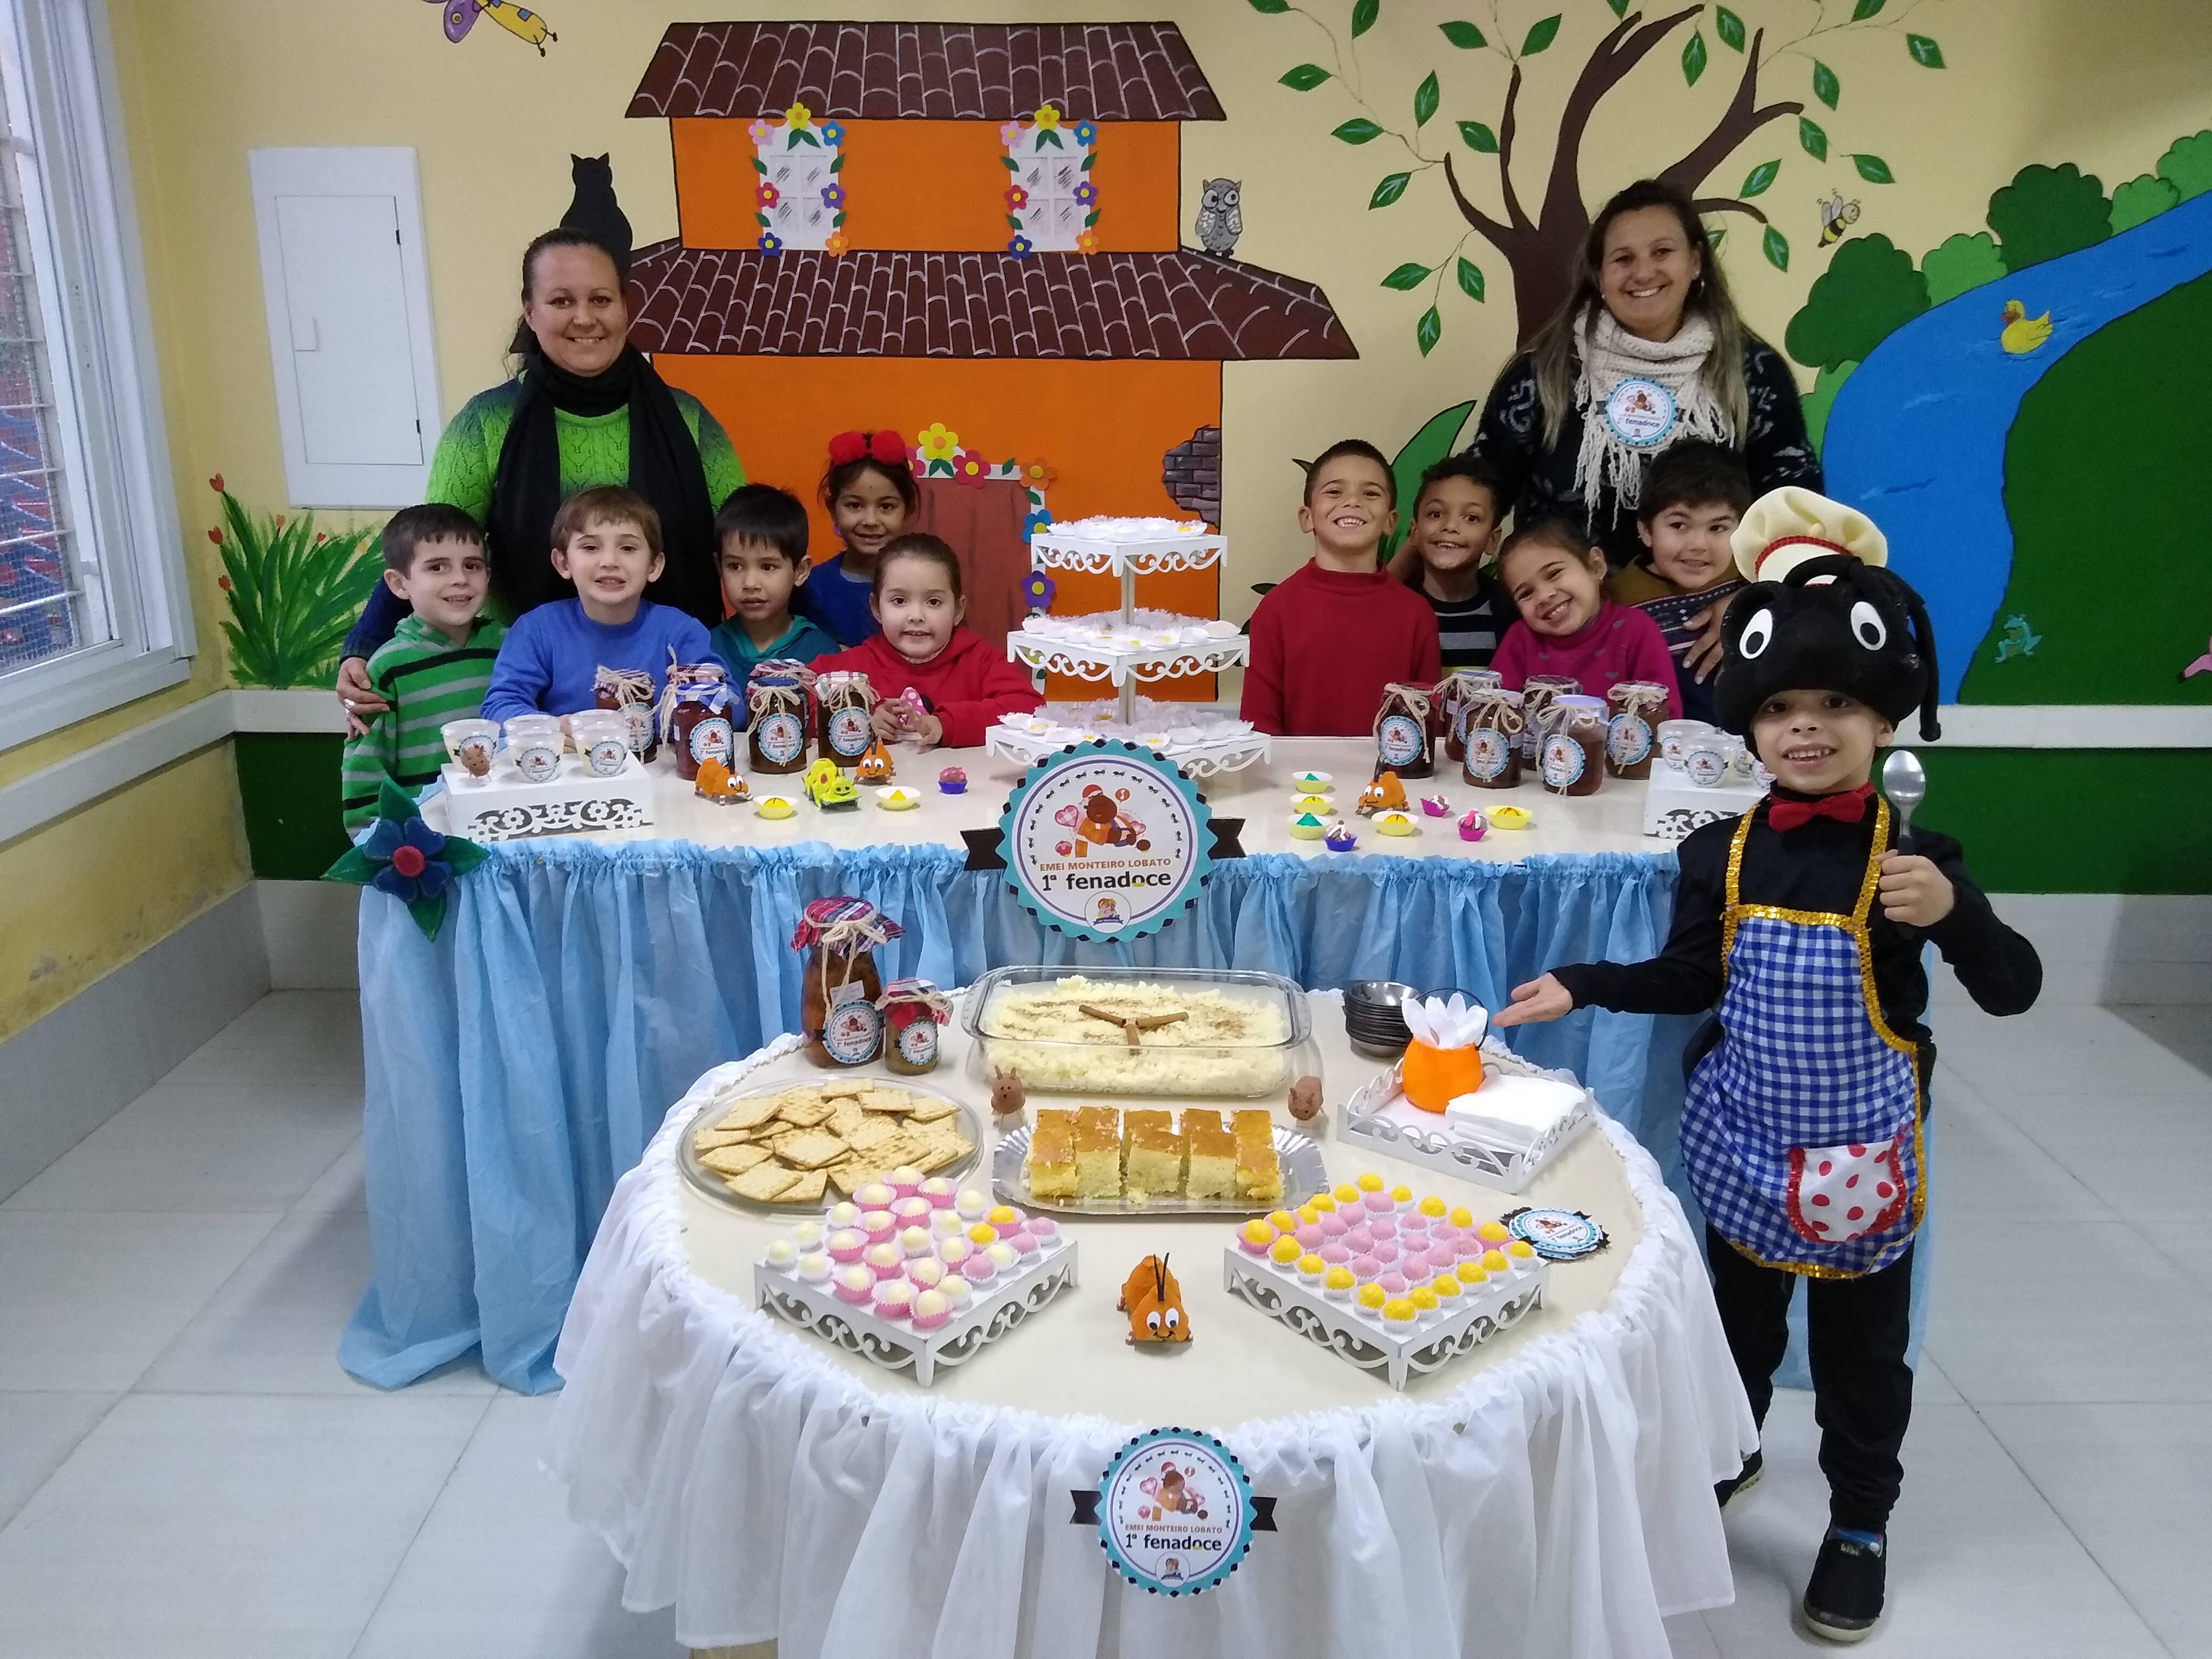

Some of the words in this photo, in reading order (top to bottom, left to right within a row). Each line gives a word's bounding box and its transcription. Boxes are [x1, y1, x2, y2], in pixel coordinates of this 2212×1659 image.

[1040, 862, 1064, 872] EMEI
[1068, 860, 1125, 871] MONTEIRO
[1128, 858, 1171, 868] LOBATO
[1065, 871, 1171, 890] fenadoce
[1146, 1524, 1189, 1533] MONTEIRO
[1190, 1525, 1223, 1534] LOBATO
[1143, 1534, 1222, 1551] fenadoce
